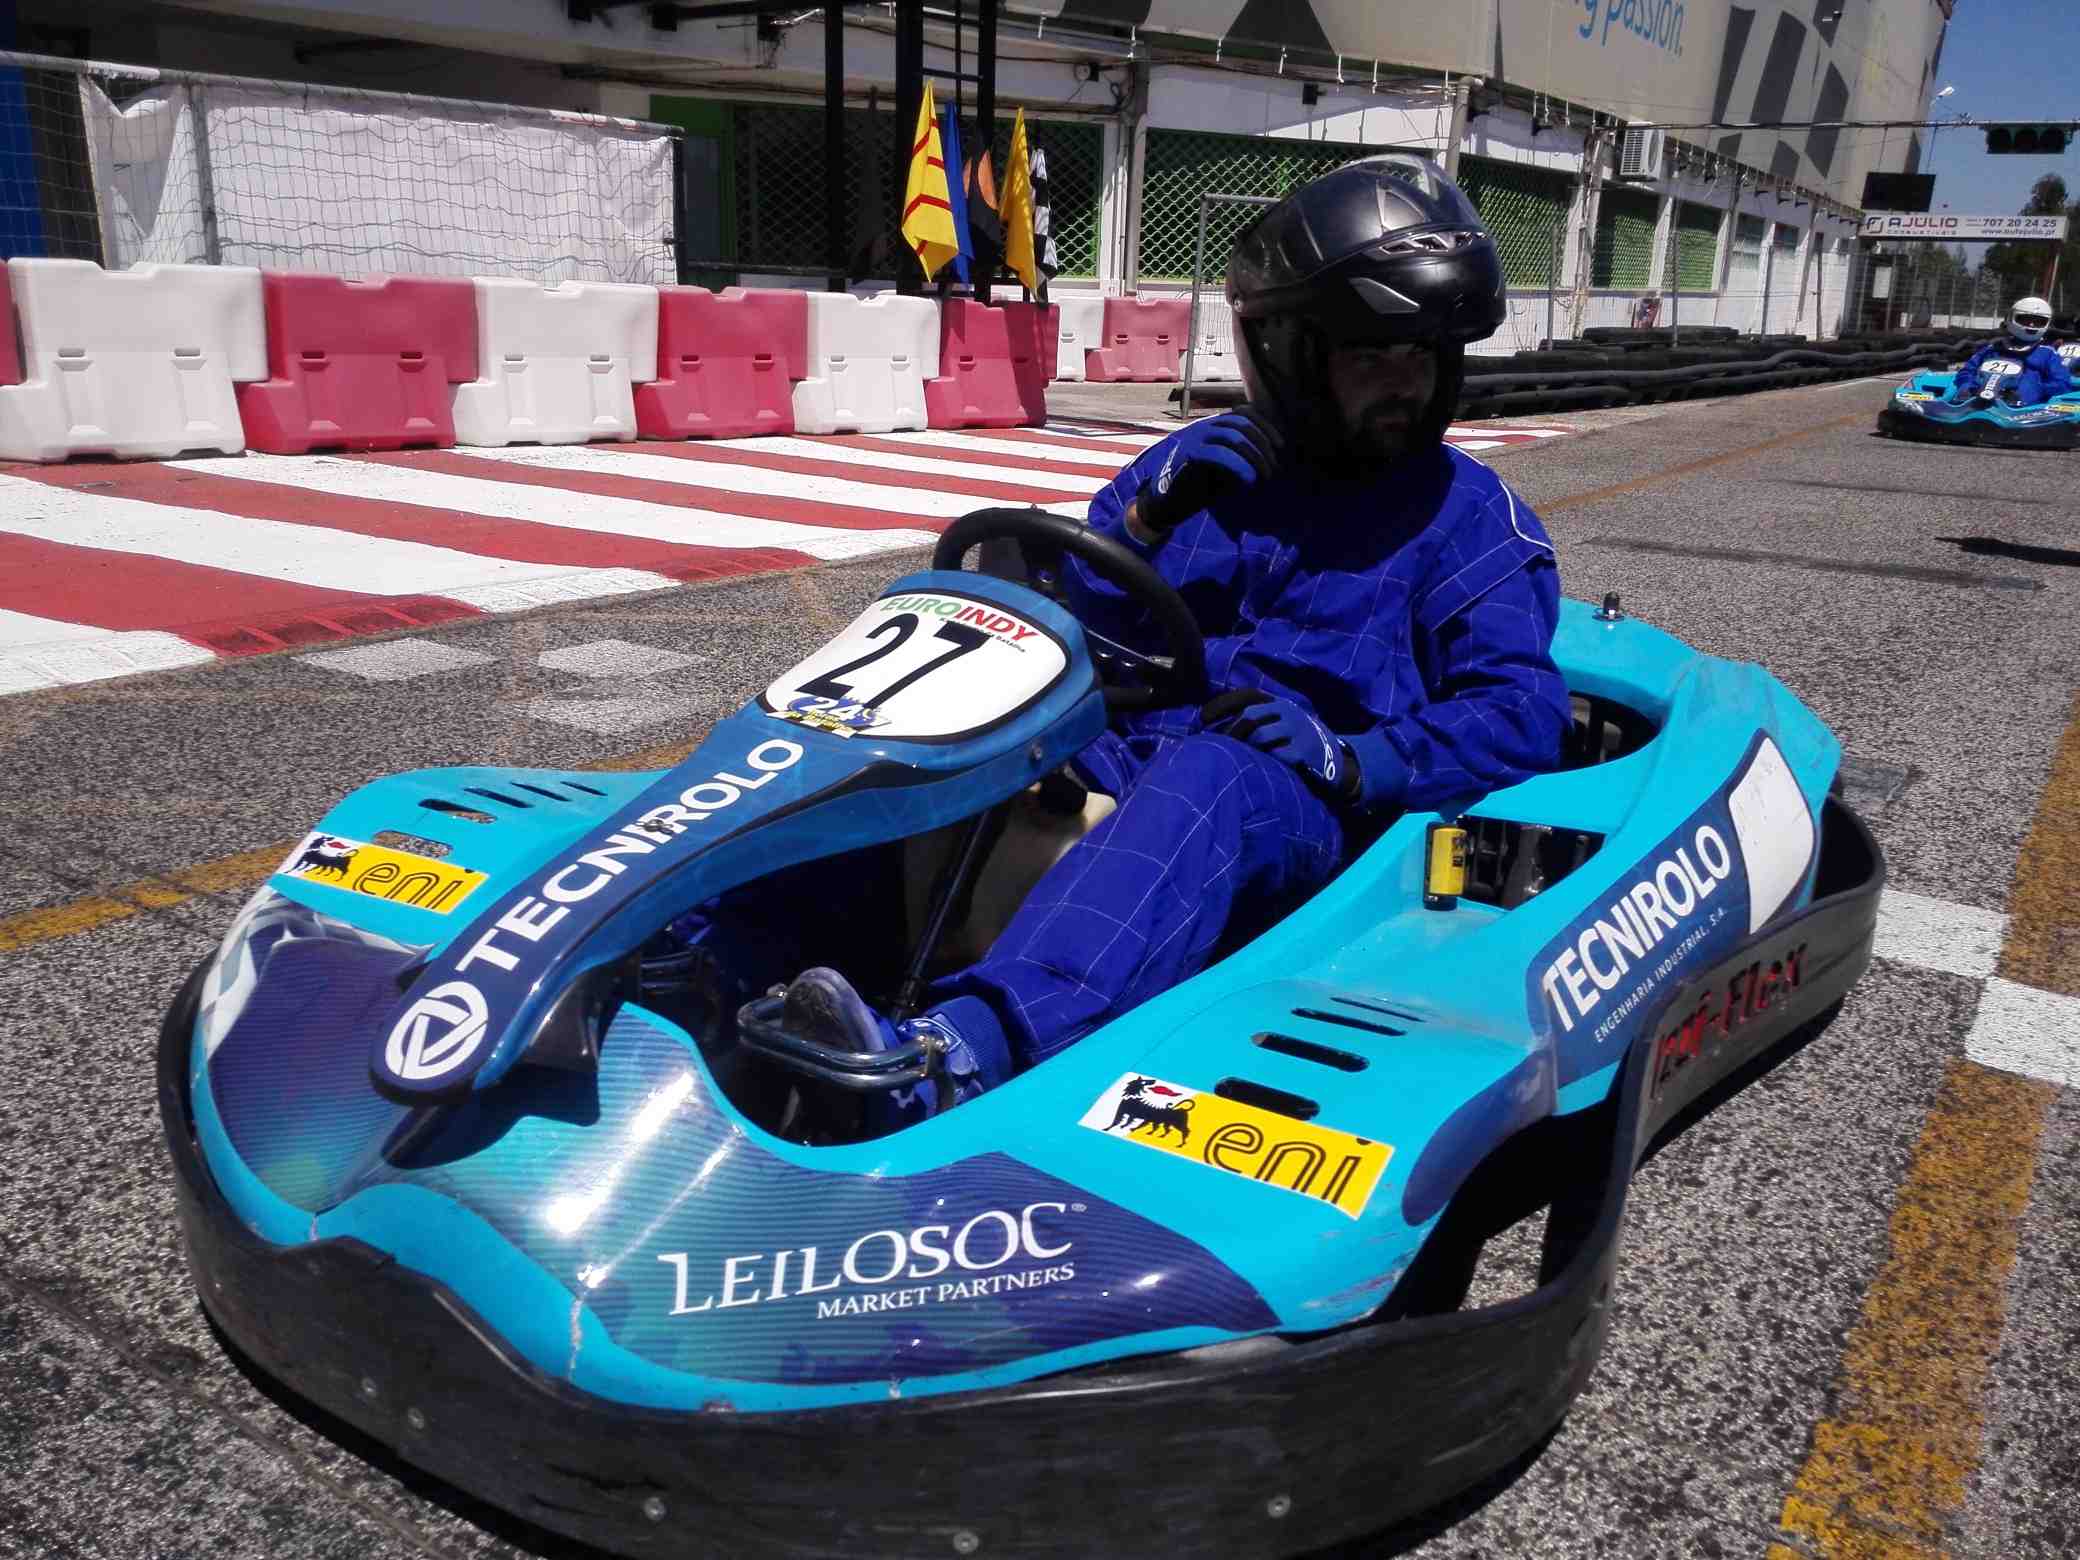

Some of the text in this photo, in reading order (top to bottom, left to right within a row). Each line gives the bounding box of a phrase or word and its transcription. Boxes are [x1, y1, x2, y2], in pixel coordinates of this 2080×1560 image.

[1983, 218, 2004, 228] 707
[2007, 218, 2021, 228] 20
[2025, 218, 2039, 228] 24
[2042, 218, 2057, 228] 25
[1989, 361, 2009, 373] 21
[880, 597, 1039, 641] EUROINDY
[795, 613, 991, 710] 27
[352, 862, 475, 910] eni
[455, 739, 804, 973] TECNIROLO
[1542, 825, 1731, 1033] TECNIROLO
[1594, 977, 1656, 1044] ENGENHARIA
[1709, 907, 1728, 927] S.A.
[1204, 1121, 1373, 1206] eni
[816, 1262, 1076, 1320] MARKET PARTNERS
